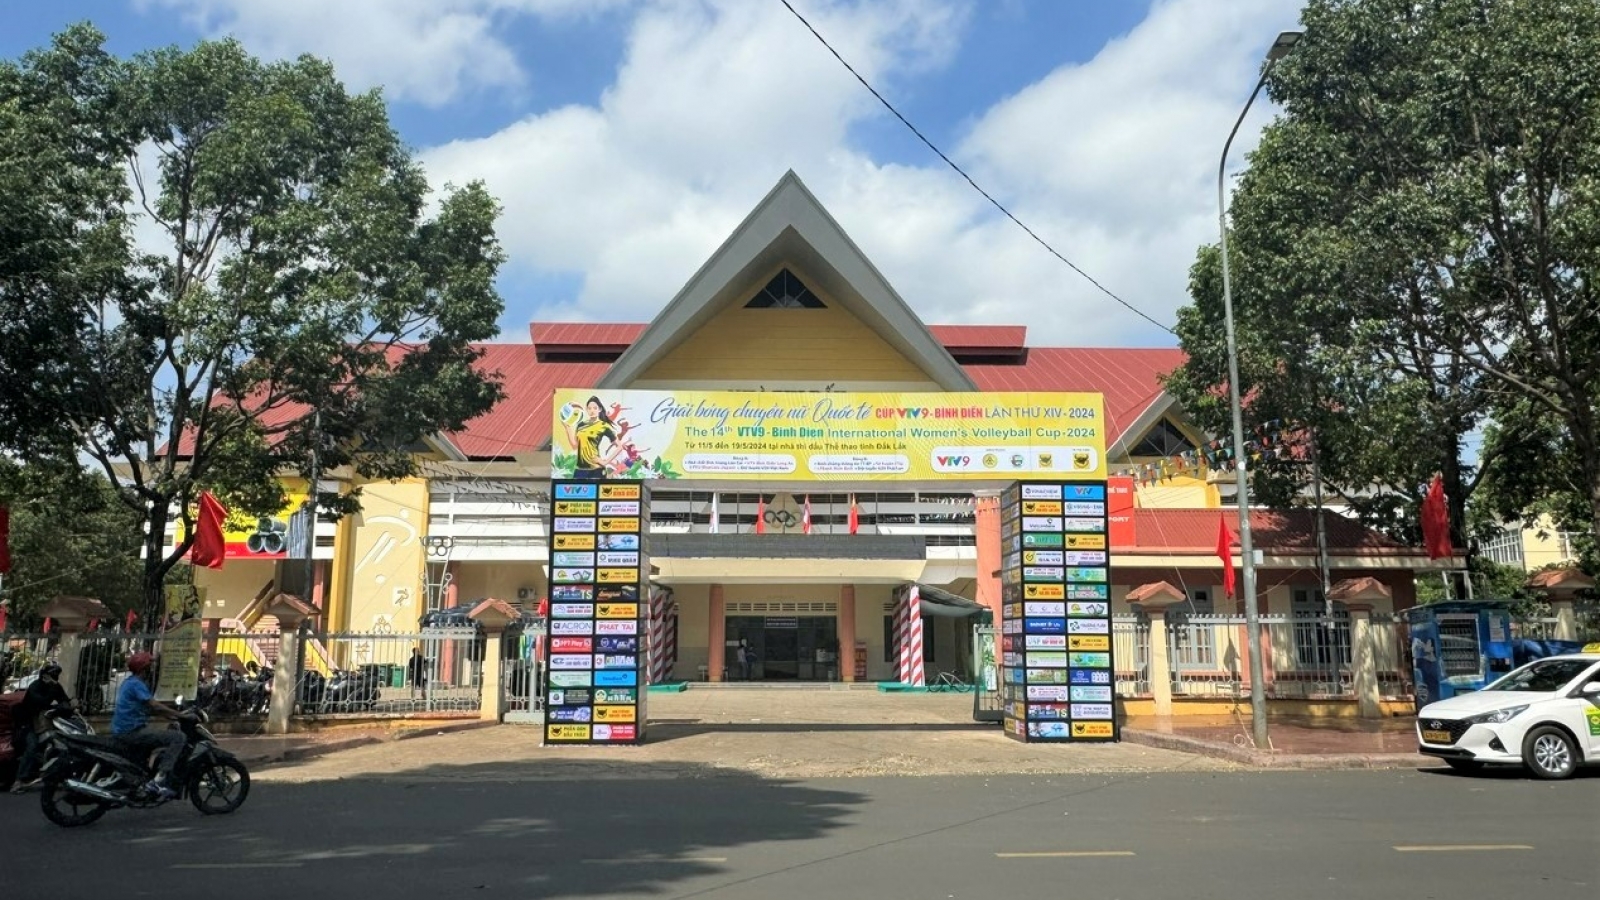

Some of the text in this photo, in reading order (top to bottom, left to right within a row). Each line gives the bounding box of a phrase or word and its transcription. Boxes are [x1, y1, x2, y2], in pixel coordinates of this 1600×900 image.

[650, 397, 693, 424] Giải
[694, 399, 730, 429] bóng
[812, 398, 854, 427] Quốc
[856, 402, 873, 420] tế
[685, 427, 708, 437] The
[799, 426, 824, 437] Dien
[828, 428, 906, 438] International
[910, 428, 968, 438] Women's
[972, 427, 1032, 440] Volleyball
[685, 441, 696, 449] Từ
[731, 442, 767, 450] 19/5/2024
